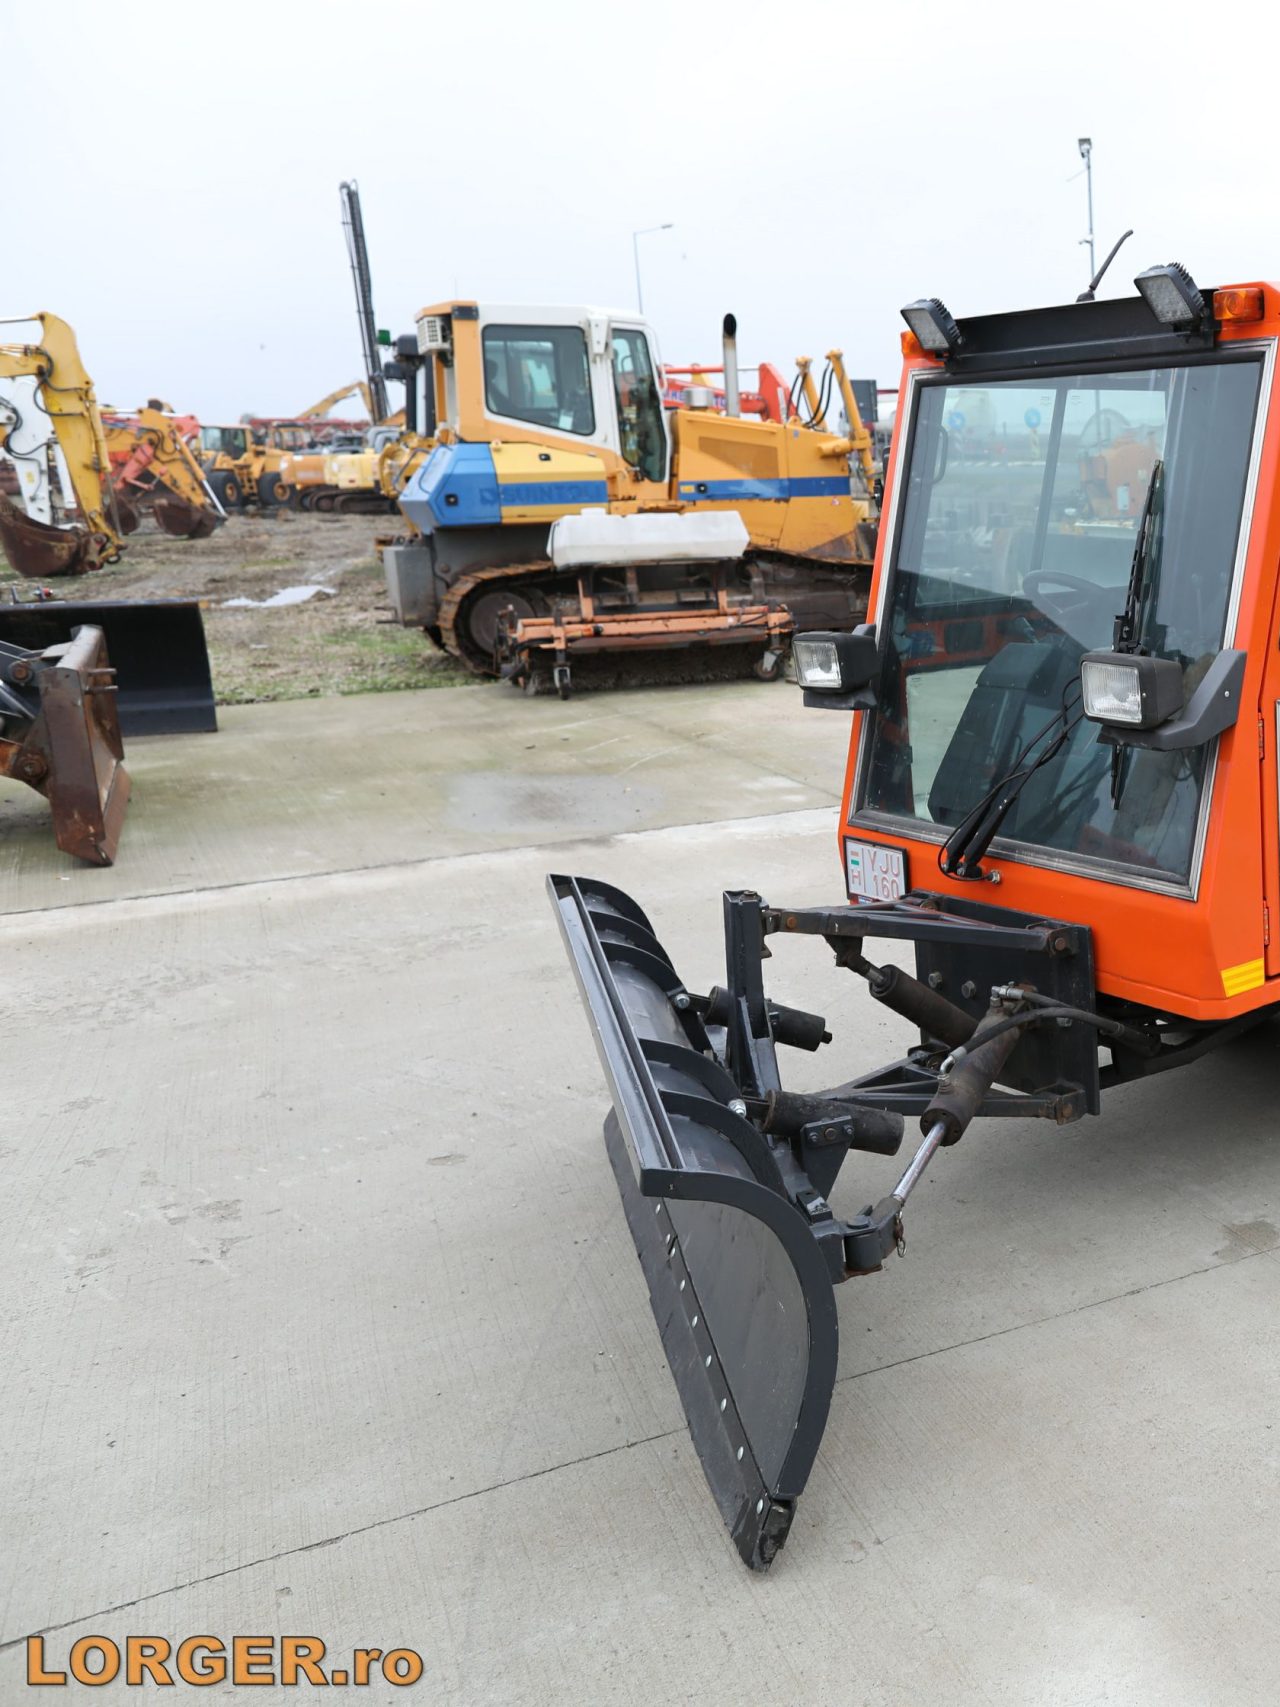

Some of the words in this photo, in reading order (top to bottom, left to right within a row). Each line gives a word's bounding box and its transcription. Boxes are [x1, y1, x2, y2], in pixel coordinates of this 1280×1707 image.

[867, 848, 900, 878] YJU
[851, 868, 861, 886] H
[873, 874, 900, 900] 160
